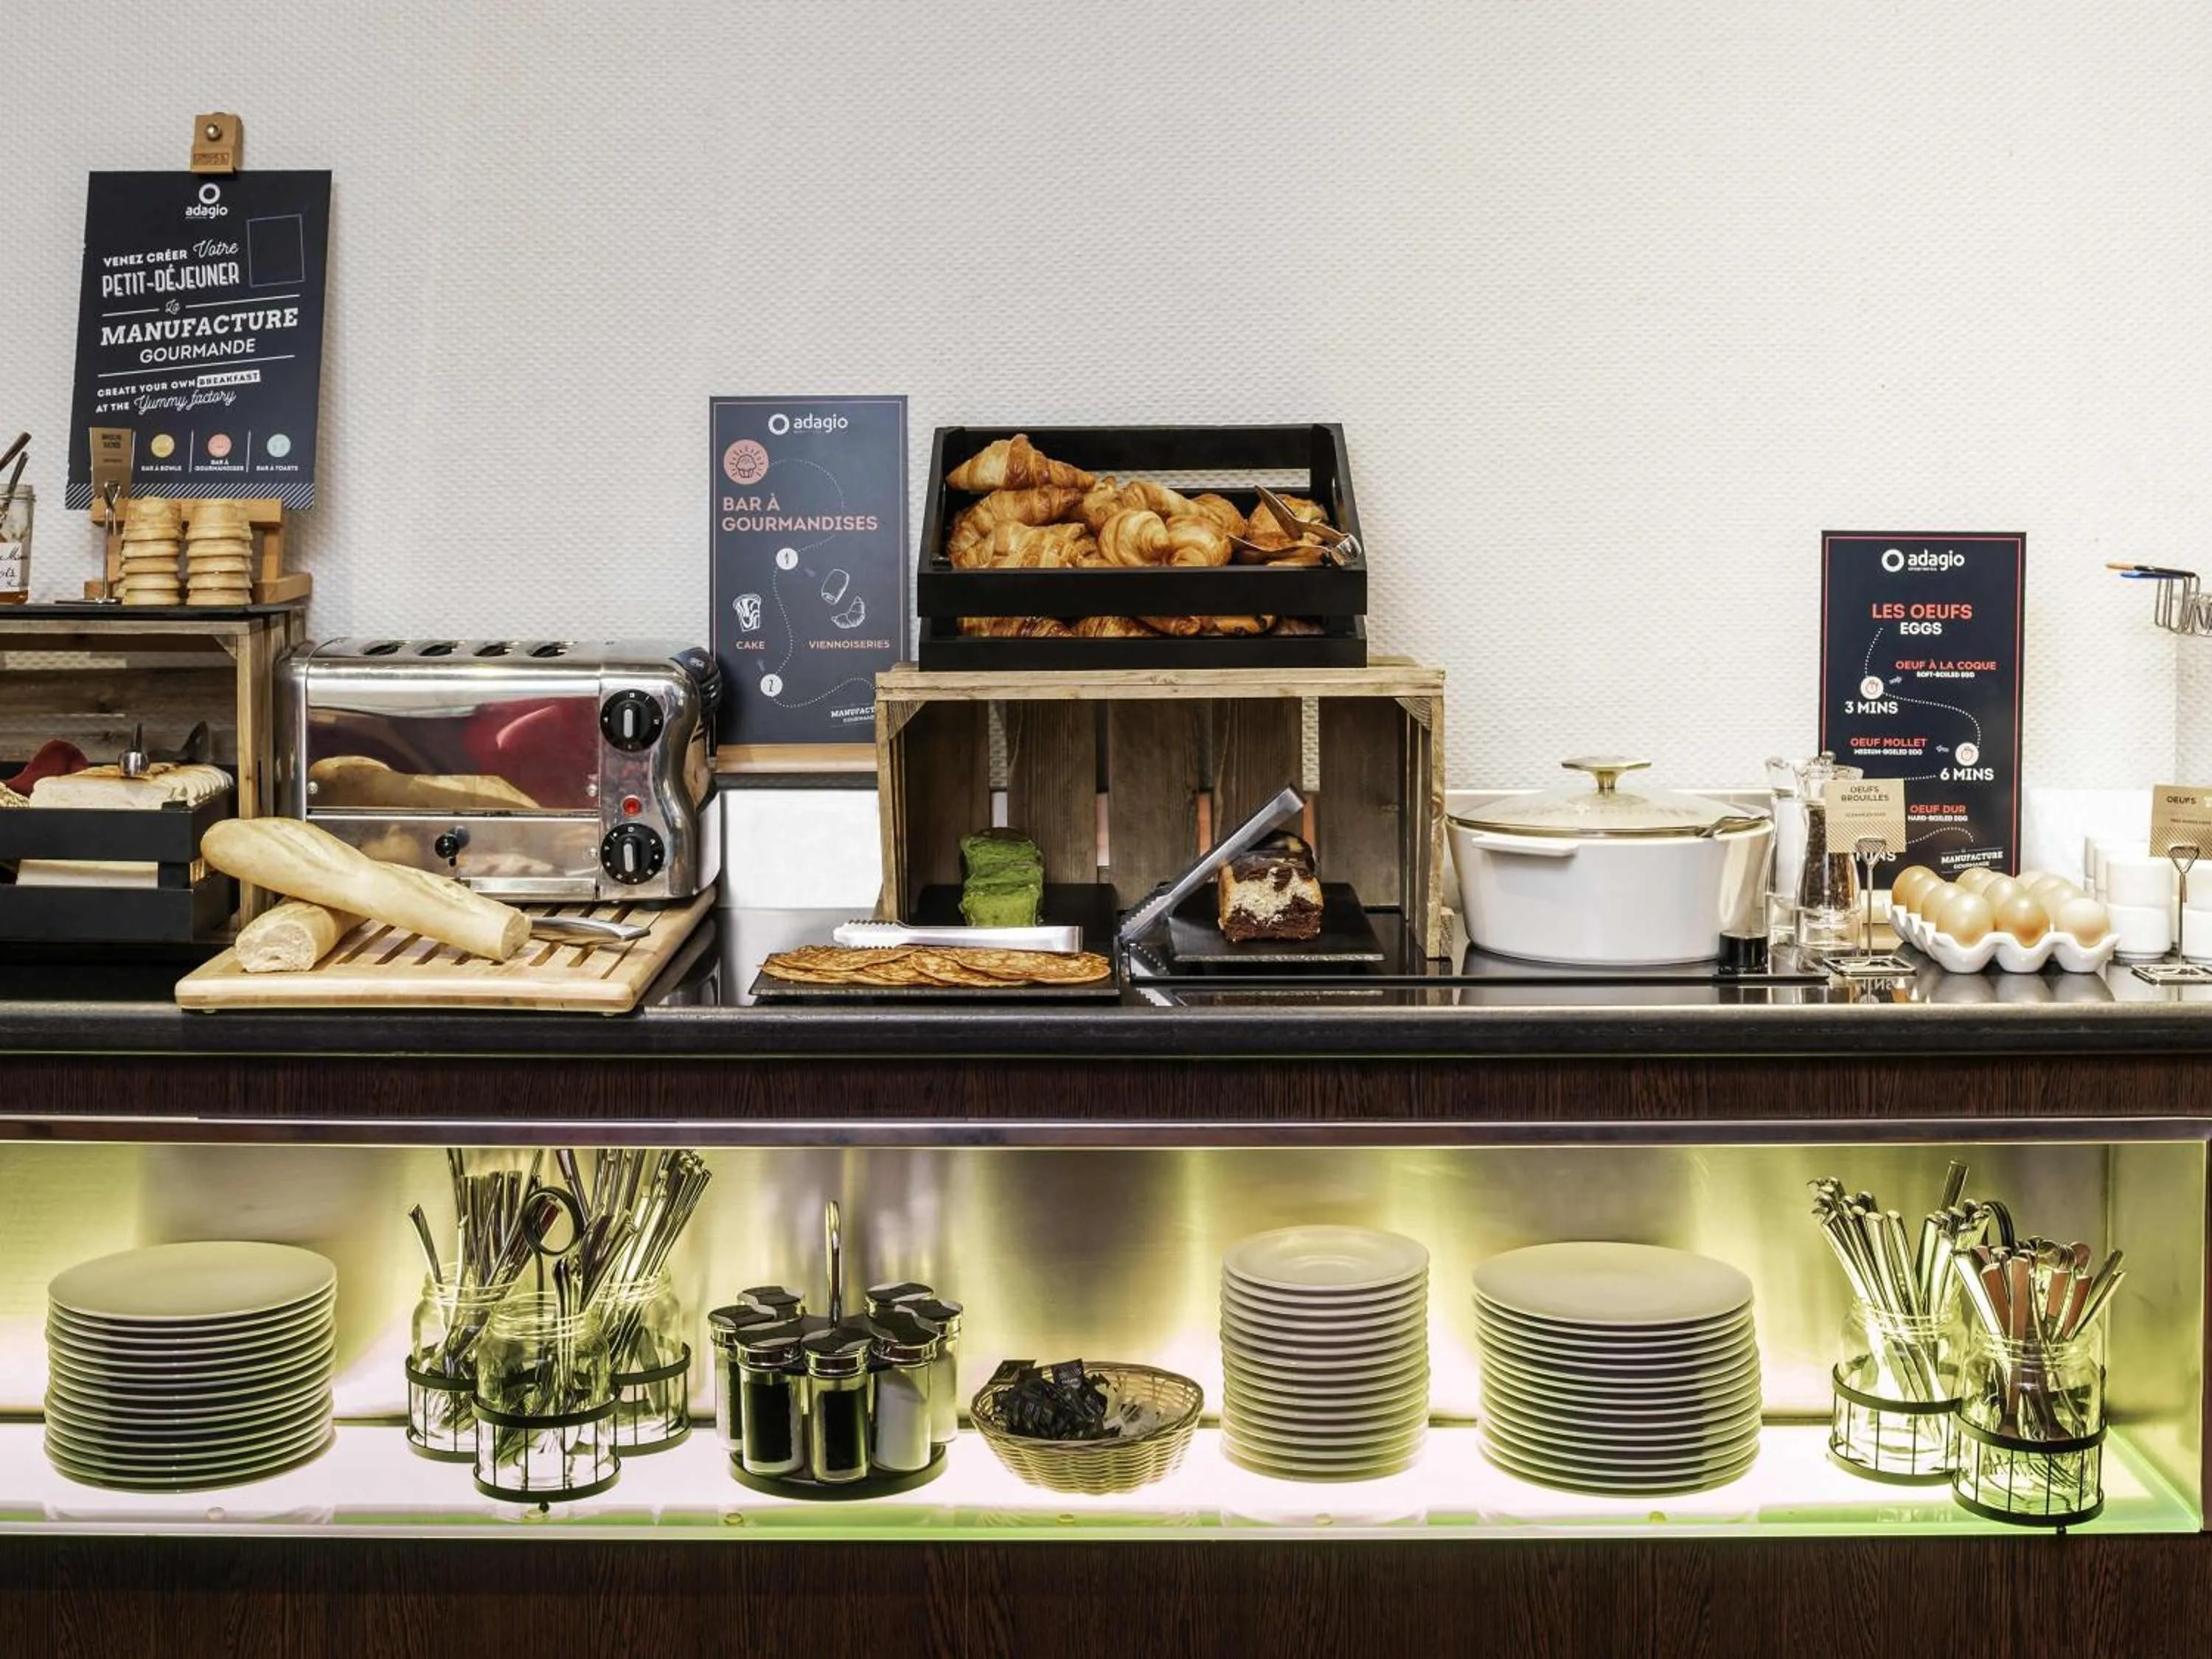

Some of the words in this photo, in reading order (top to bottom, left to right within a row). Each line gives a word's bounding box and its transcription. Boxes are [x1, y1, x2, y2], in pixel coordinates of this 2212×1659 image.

[185, 204, 228, 219] adagio
[103, 251, 144, 267] VENEZ
[147, 248, 187, 263] CRÉER
[192, 238, 240, 258] Votre
[102, 262, 240, 298] PETIT-DÉJEUNER
[100, 307, 299, 346] MANUFACTURE
[139, 338, 257, 364] GOURMANDE
[97, 386, 136, 397] CREATE
[139, 383, 168, 393] YOUR
[170, 379, 195, 389] OWN
[198, 371, 260, 386] BREAKFAST
[95, 404, 107, 414] AT
[110, 402, 130, 411] THE
[133, 394, 187, 416] Yummy
[185, 389, 237, 411] factory
[793, 413, 849, 433] adagio
[723, 496, 762, 511] BAR
[766, 493, 781, 511] À
[722, 516, 878, 532] GOURMANDISES
[1907, 548, 1965, 571] adagio
[1872, 603, 1905, 619] LES
[1910, 603, 1973, 619] OEUFS
[1899, 622, 1942, 636] EGGS
[736, 640, 765, 650] CAKE
[809, 639, 891, 650] VIENNOISERIES
[1896, 661, 1925, 669] OEUF
[1928, 658, 1937, 669] À
[1940, 661, 1955, 669] LA
[1957, 661, 1997, 670] COQUE
[831, 706, 875, 718] MANUFACT
[1844, 700, 1854, 714] 3
[1857, 700, 1899, 714] MINS
[1850, 738, 1881, 747] OEUF
[1884, 737, 1928, 747] MOLLET
[1940, 768, 1950, 781] 6
[1953, 768, 1994, 781] MINS
[2166, 796, 2197, 804] OEUFS
[1910, 804, 1940, 813] OEUF
[1943, 804, 1966, 813] DUR
[1941, 850, 2003, 864] MANUFACTURE
